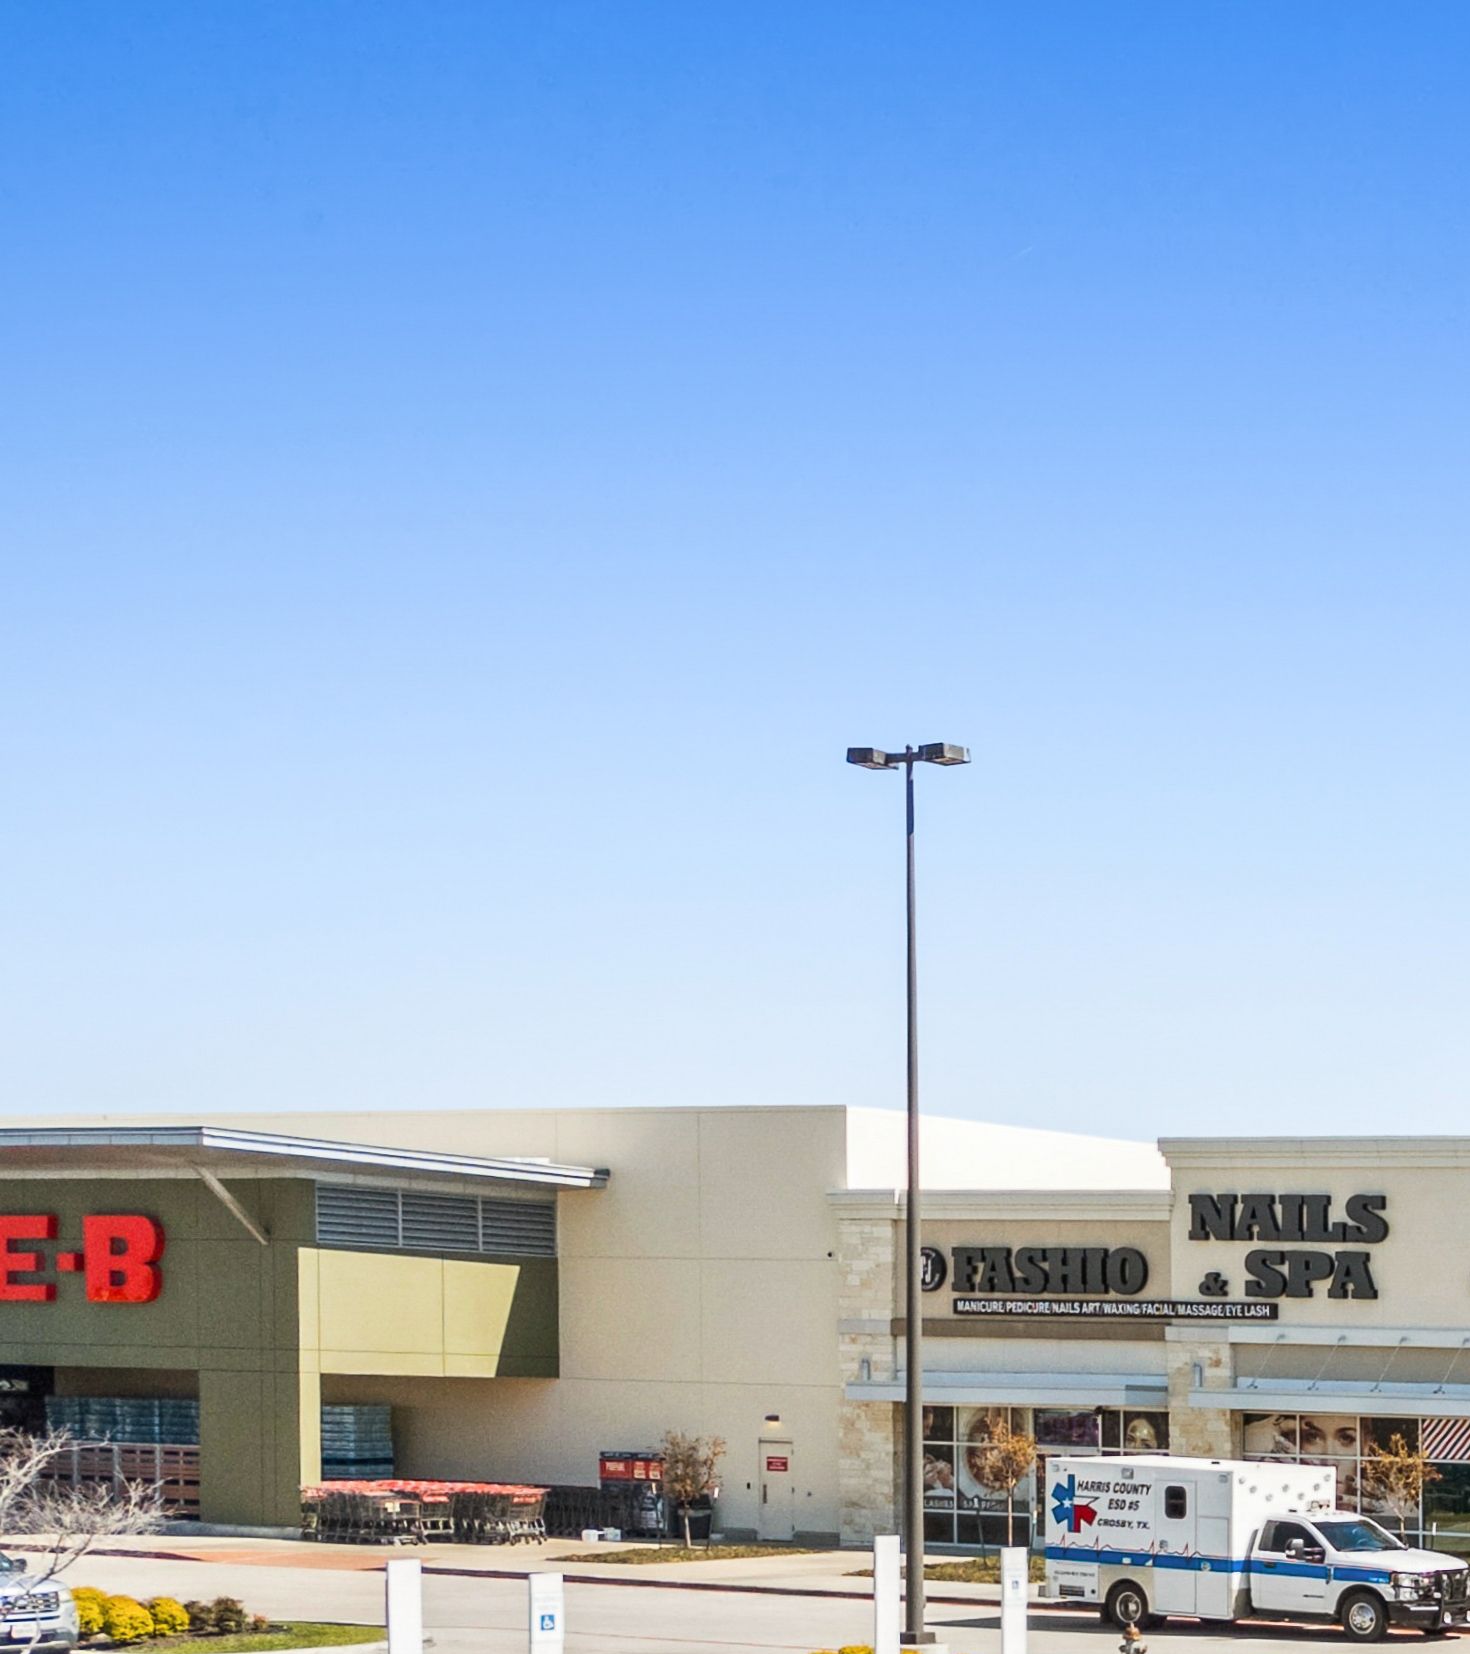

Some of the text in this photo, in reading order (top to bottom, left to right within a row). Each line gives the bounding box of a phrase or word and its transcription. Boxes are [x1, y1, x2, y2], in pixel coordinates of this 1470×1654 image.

[1188, 1193, 1390, 1243] NAILS
[951, 1247, 1150, 1295] FASHIO
[1199, 1250, 1379, 1300] & SPA
[1244, 1304, 1270, 1317] LASH
[1077, 1480, 1152, 1495] HARRIS COUNTY
[1108, 1499, 1140, 1511] ESD #5
[1097, 1519, 1133, 1529] CROSBY,
